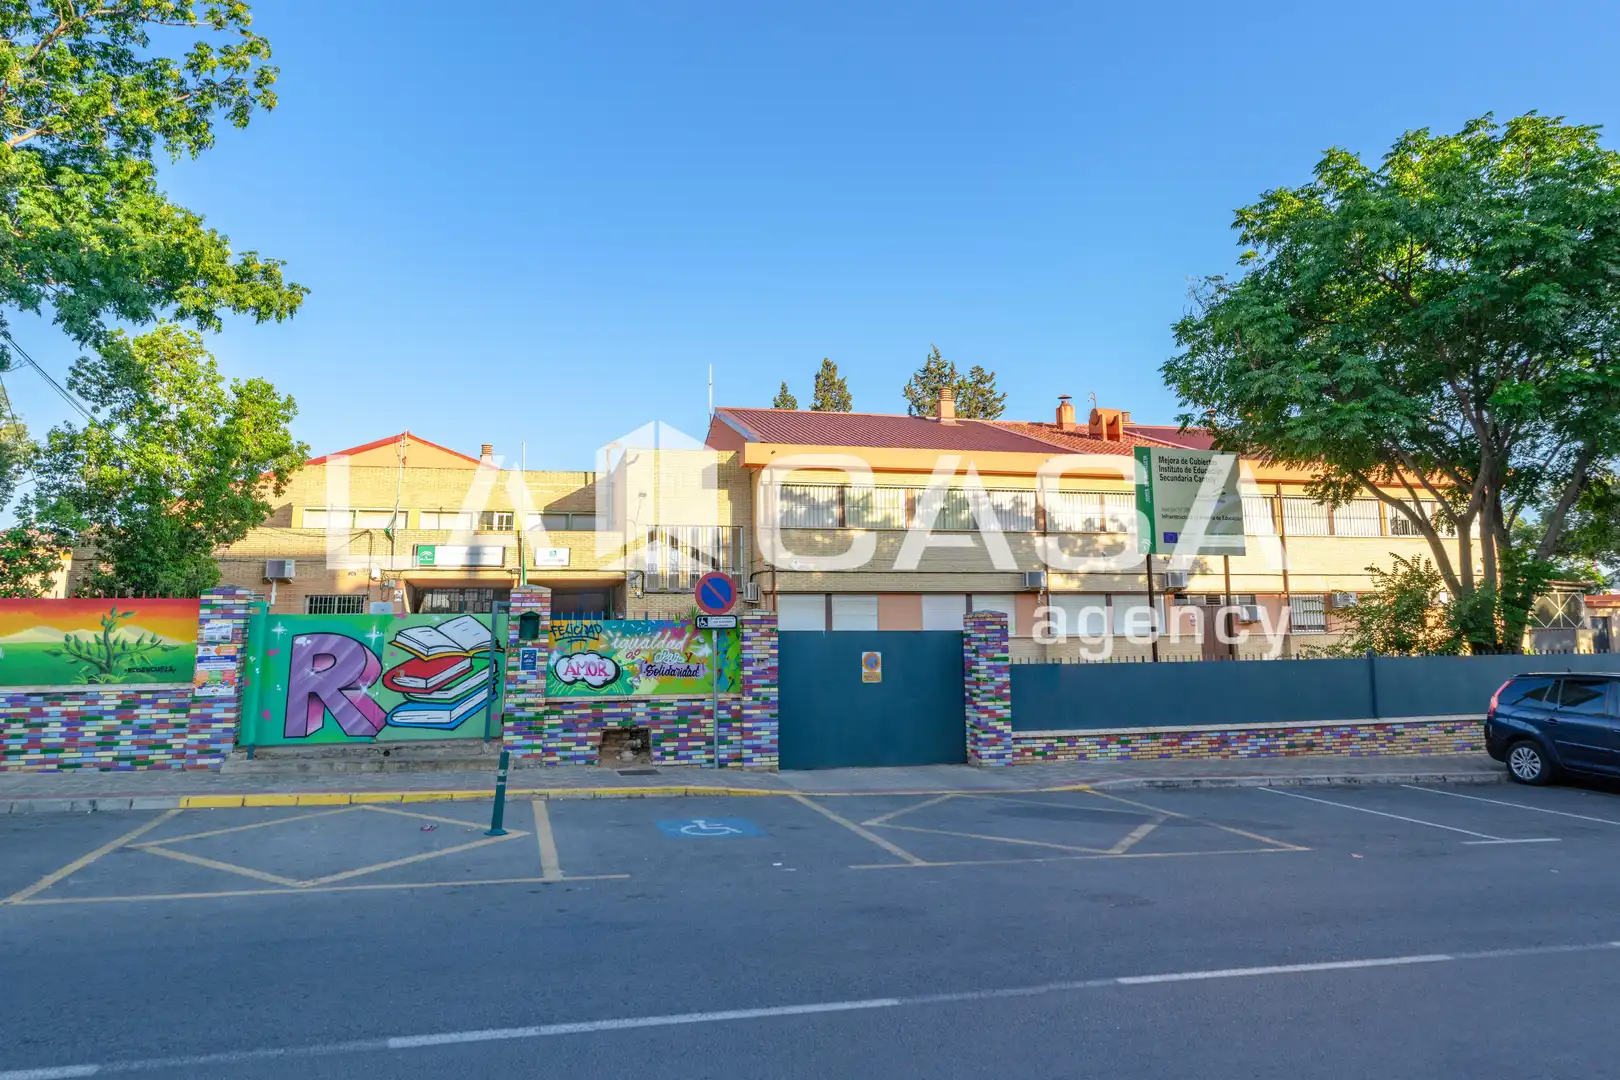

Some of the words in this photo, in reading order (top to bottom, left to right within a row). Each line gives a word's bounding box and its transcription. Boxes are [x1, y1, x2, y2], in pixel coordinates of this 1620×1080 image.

[1158, 455, 1180, 466] Mejora
[1158, 465, 1184, 474] Instituto
[1184, 466, 1192, 474] de
[1159, 473, 1194, 482] Secundaria
[564, 661, 611, 677] AMOR
[645, 664, 700, 677] Solidaridad
